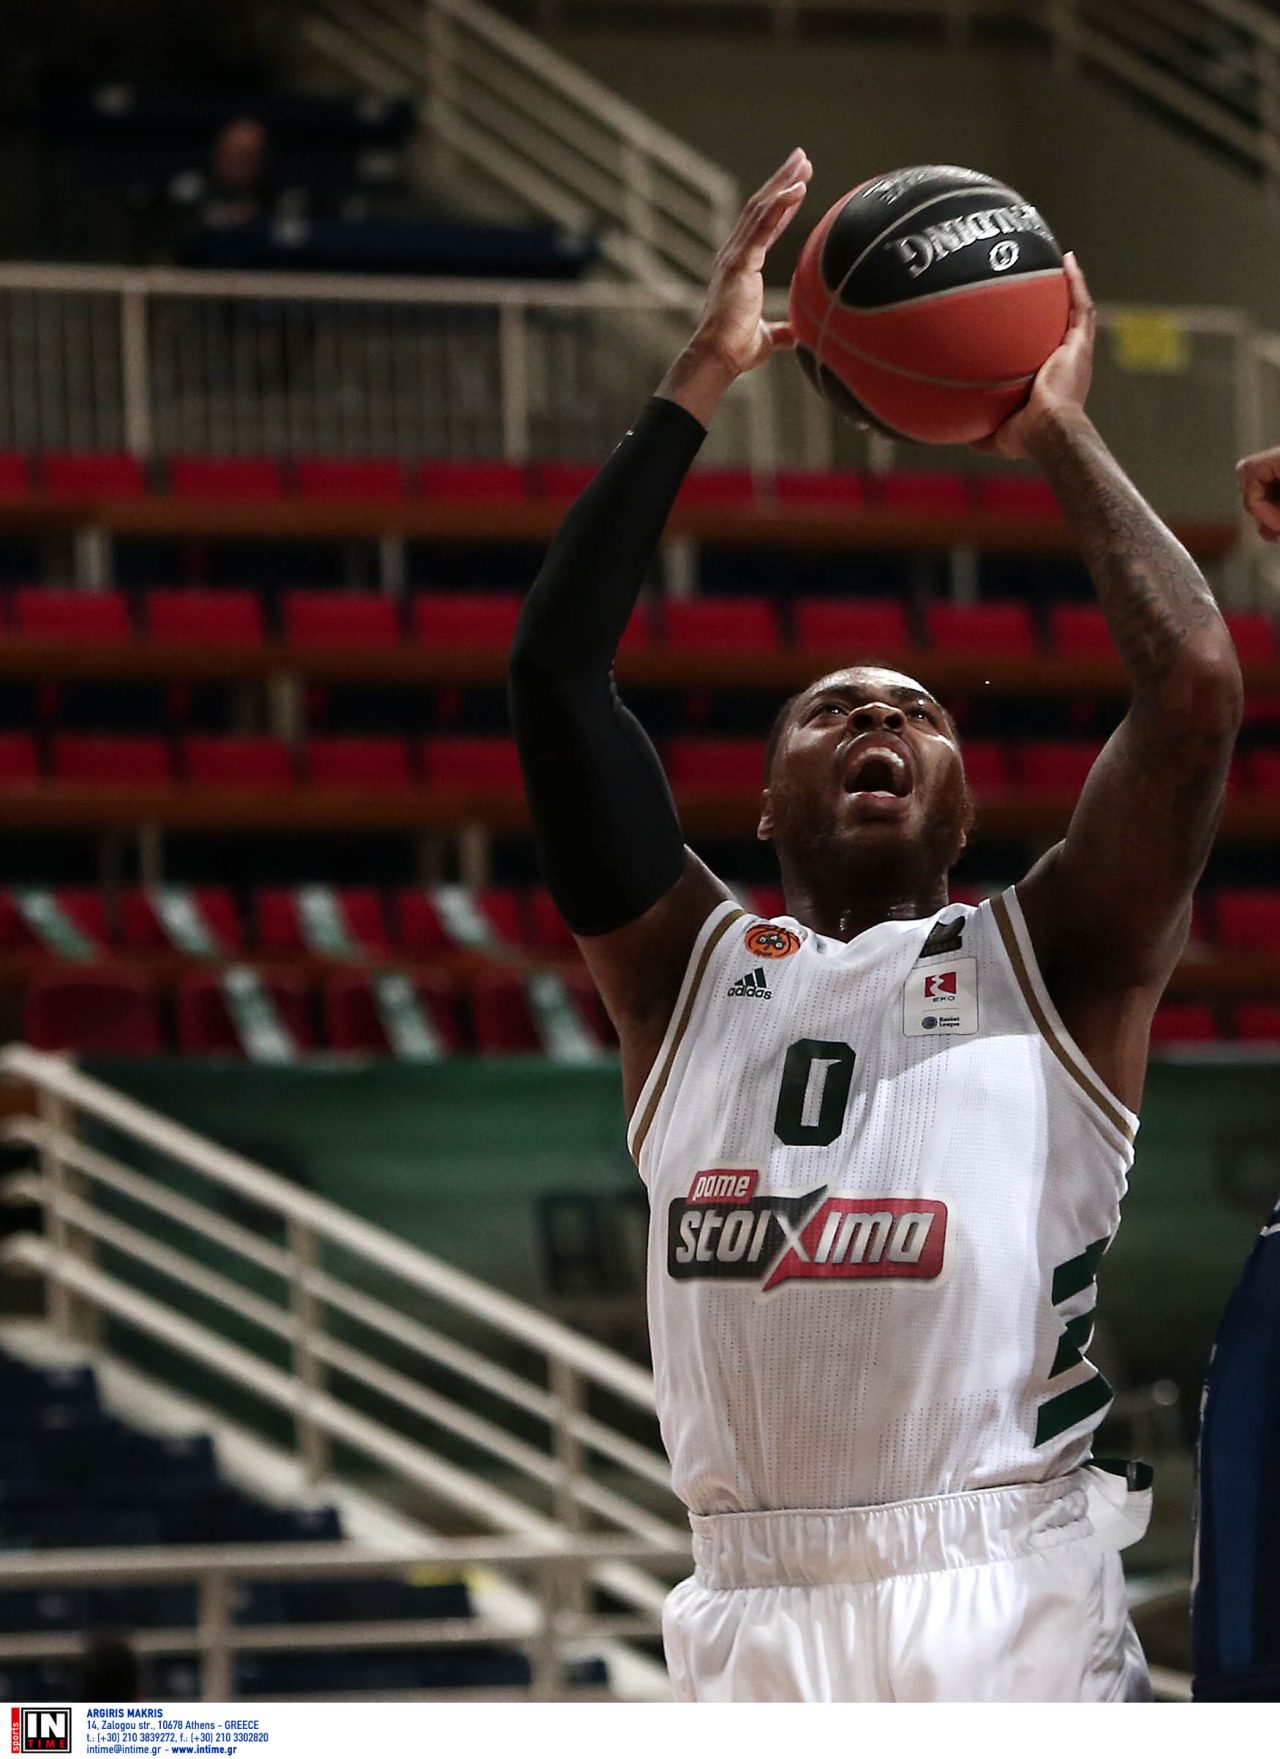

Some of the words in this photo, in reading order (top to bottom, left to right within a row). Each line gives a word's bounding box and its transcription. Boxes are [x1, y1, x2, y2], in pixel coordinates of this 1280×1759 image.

[727, 984, 772, 1000] adidas
[775, 1038, 856, 1147] 0
[693, 1174, 750, 1201] pame
